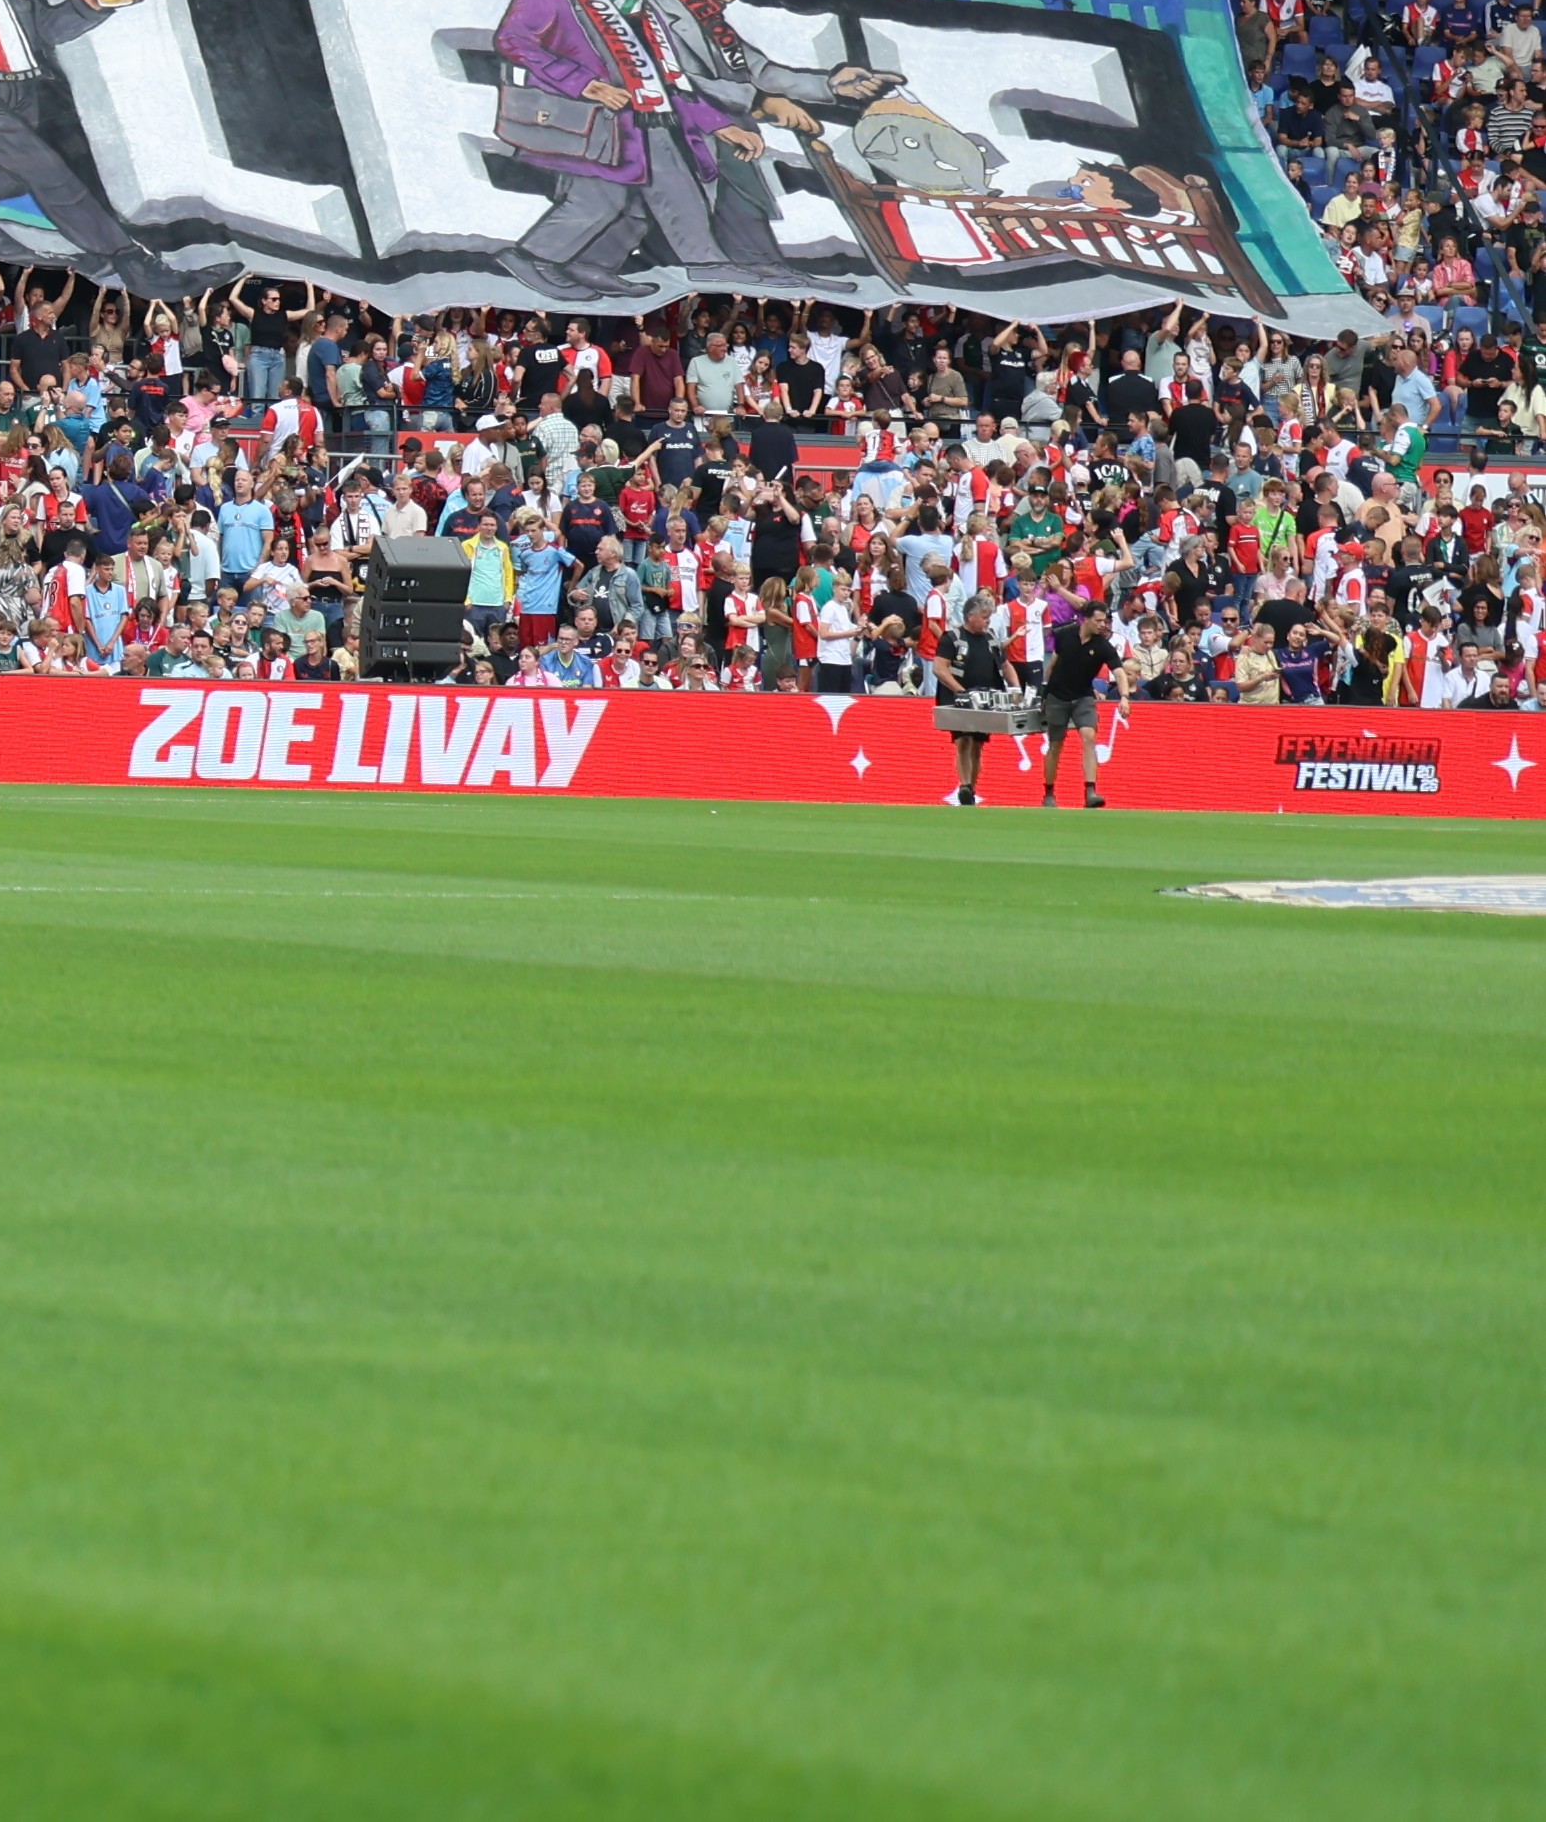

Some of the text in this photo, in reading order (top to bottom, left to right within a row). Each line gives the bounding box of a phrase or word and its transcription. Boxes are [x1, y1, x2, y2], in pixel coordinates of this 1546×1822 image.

[534, 349, 558, 362] CREW
[127, 687, 608, 788] ZOE LIVAY
[1277, 735, 1440, 763] FEYENOORD
[1296, 762, 1419, 792] FESTIVAL
[1417, 764, 1436, 778] 20
